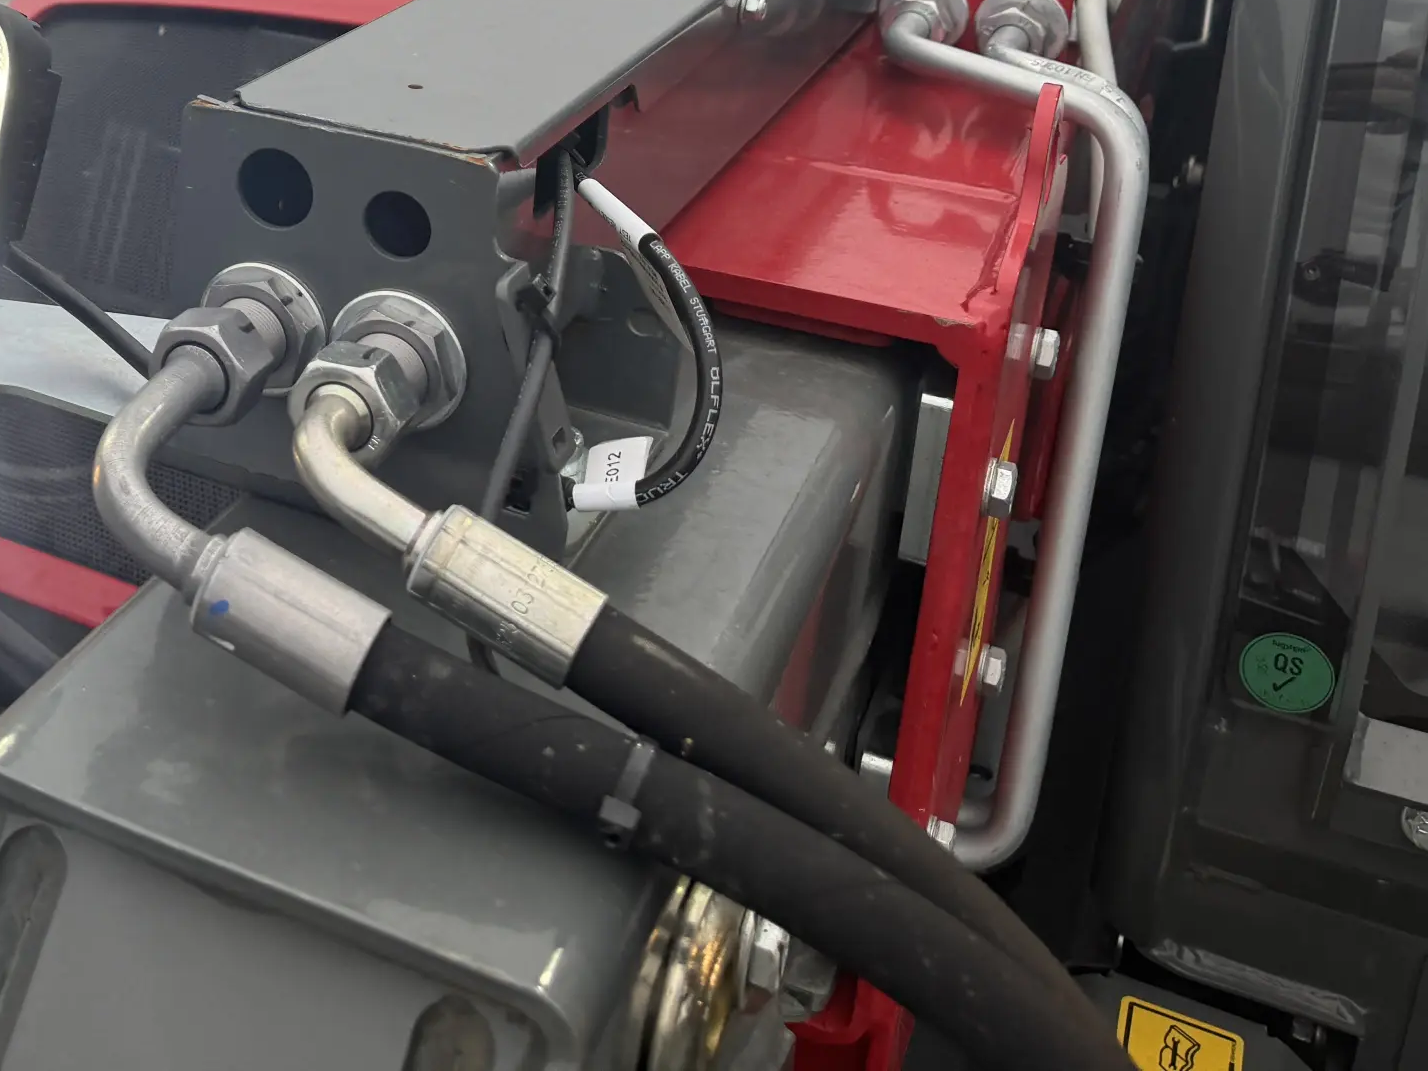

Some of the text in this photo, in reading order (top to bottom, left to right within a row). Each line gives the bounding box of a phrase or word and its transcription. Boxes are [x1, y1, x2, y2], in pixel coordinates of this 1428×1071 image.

[649, 239, 672, 261] LAPP
[667, 258, 692, 294] KABEL
[1274, 653, 1304, 676] QS
